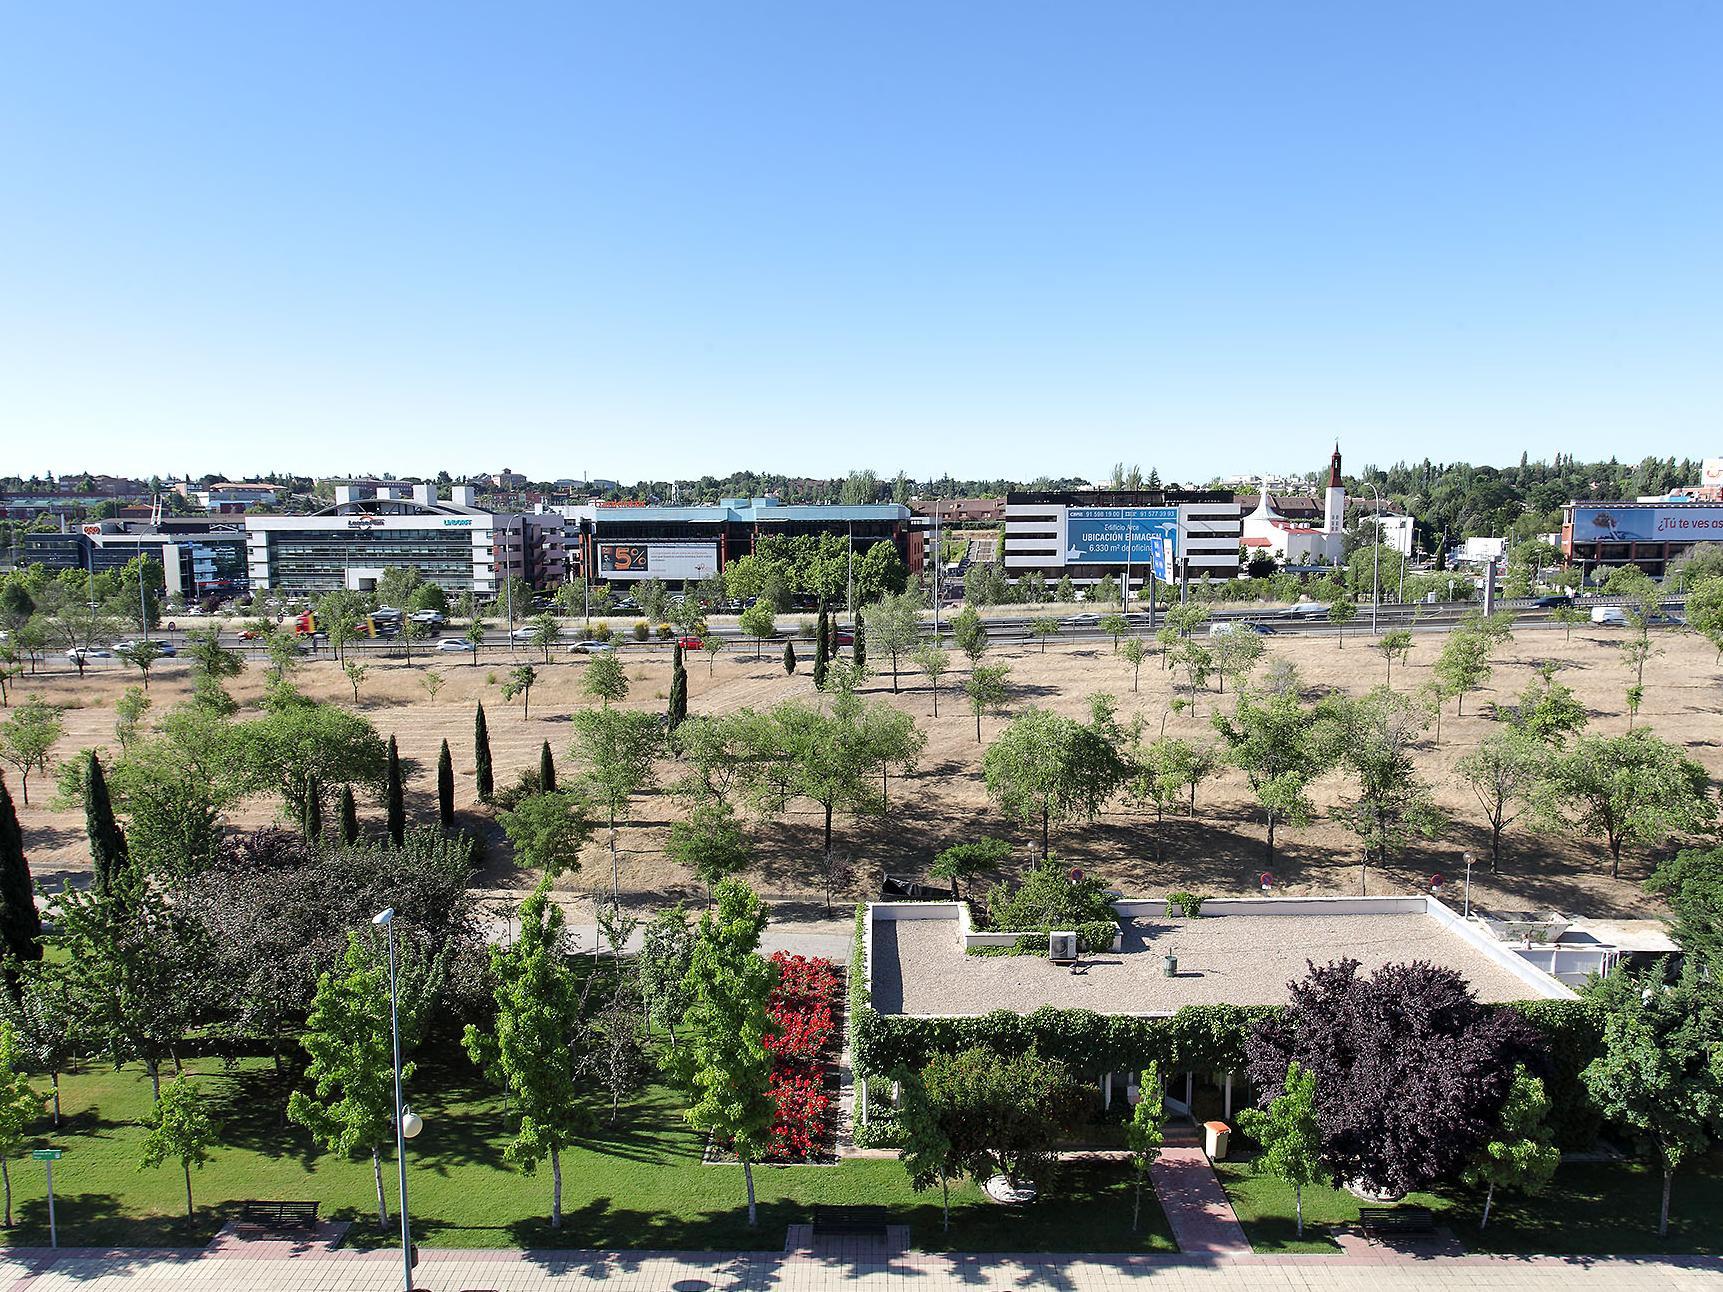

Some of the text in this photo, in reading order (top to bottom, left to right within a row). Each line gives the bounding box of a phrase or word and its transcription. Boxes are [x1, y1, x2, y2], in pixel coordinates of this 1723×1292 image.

[1104, 523, 1125, 531] Edificio
[1658, 517, 1676, 531] ¿Tú
[1679, 519, 1689, 528] te
[1692, 520, 1709, 528] ves
[1082, 532, 1123, 541] UBICACIÓN
[614, 547, 647, 570] 5%
